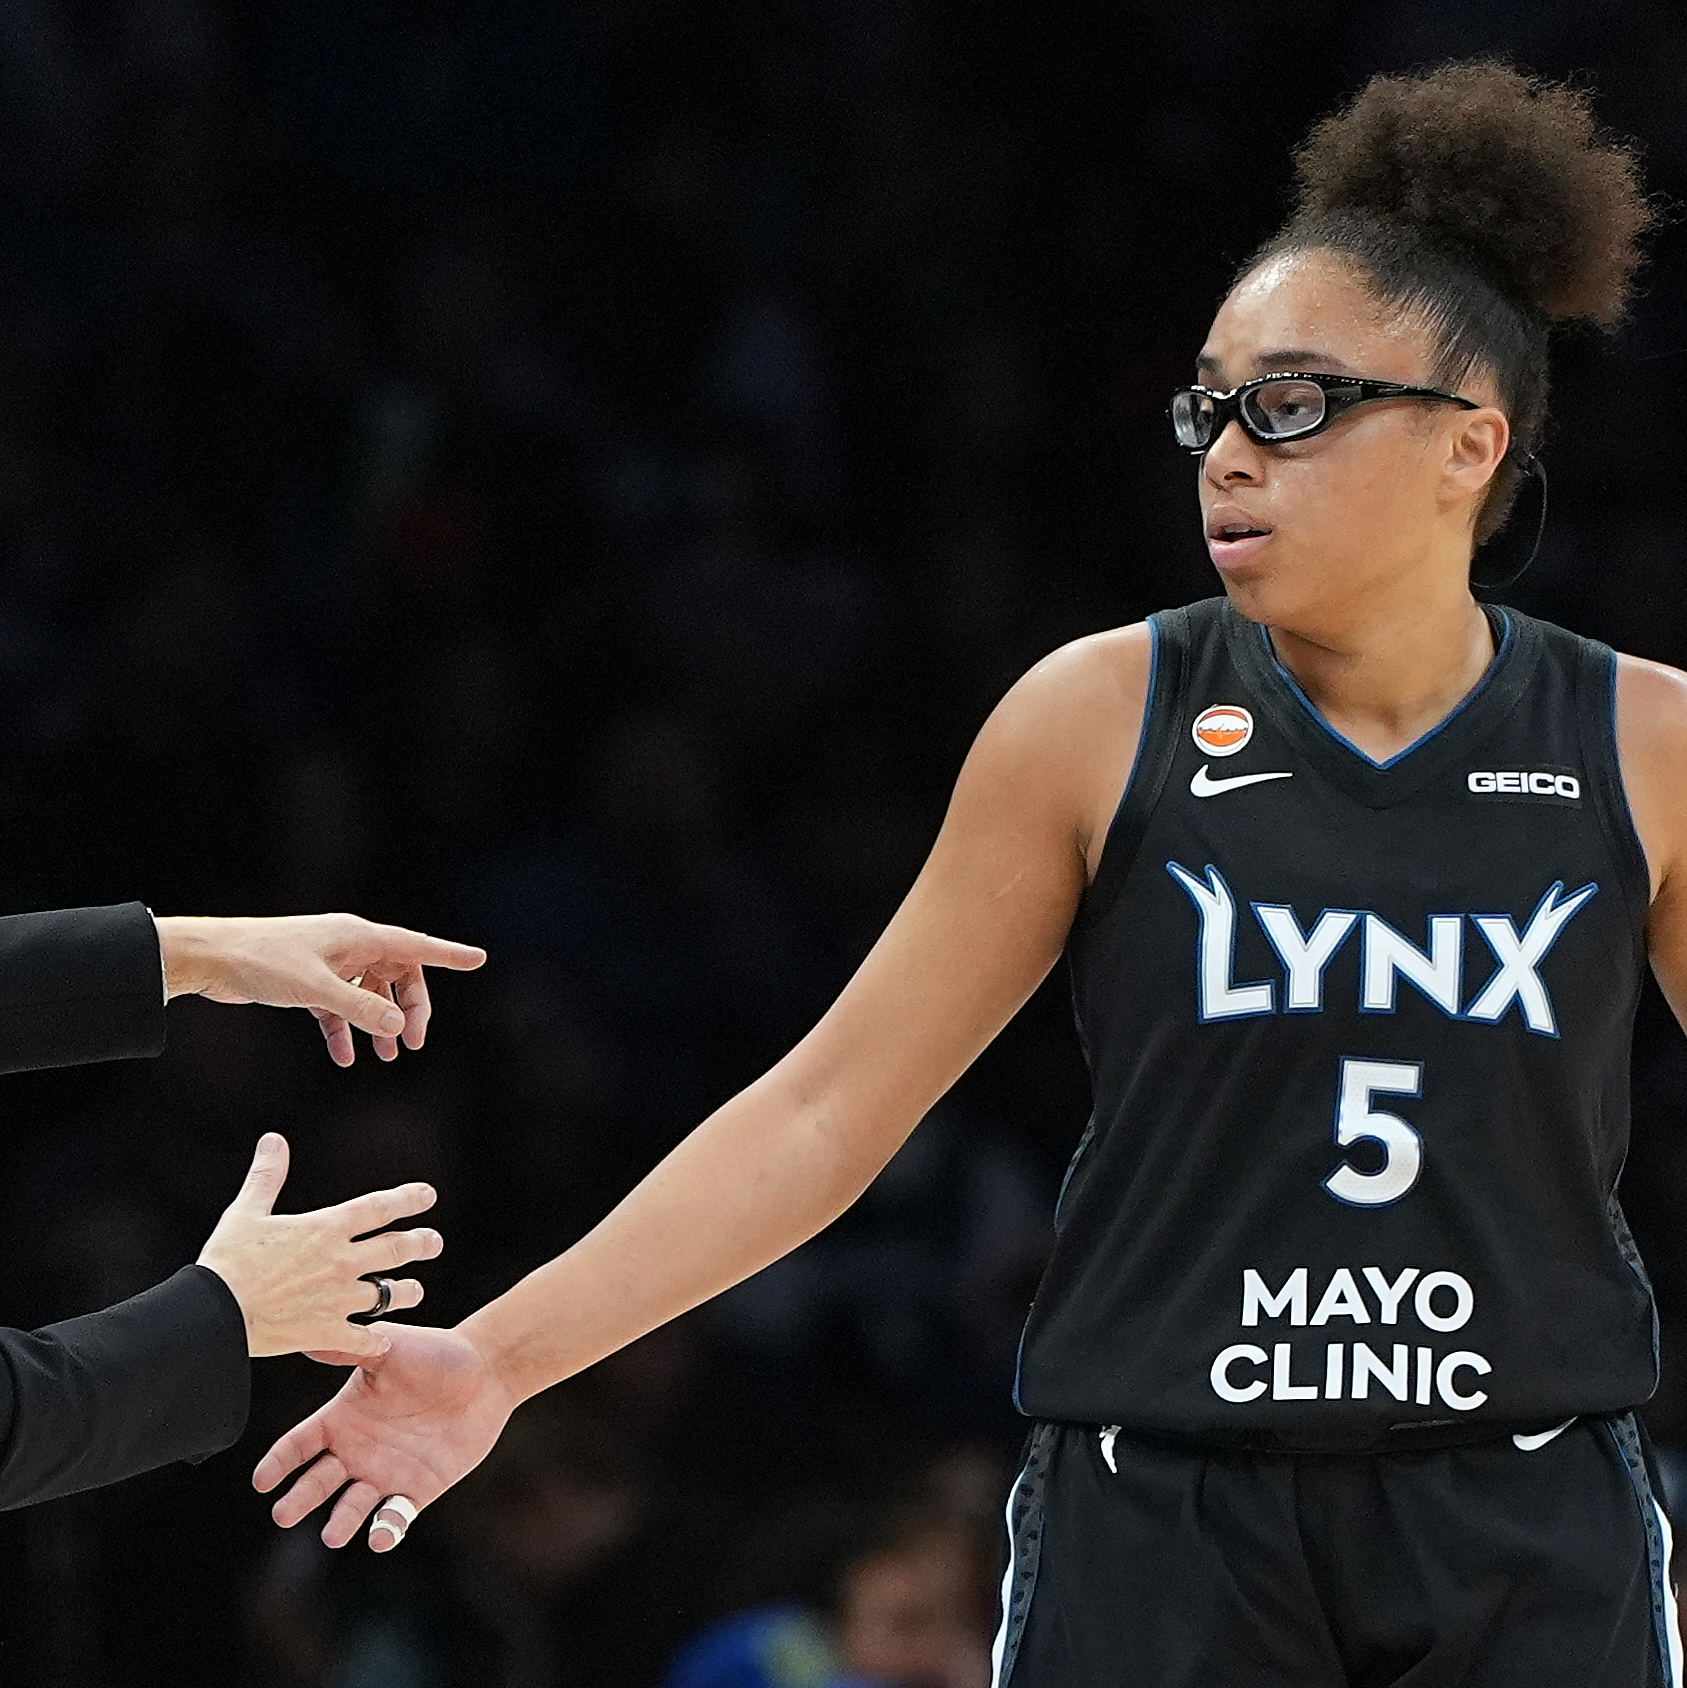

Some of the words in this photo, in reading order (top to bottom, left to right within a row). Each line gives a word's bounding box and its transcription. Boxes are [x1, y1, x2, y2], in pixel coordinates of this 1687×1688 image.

[1467, 771, 1581, 799] GEICO
[1165, 860, 1599, 1039] LYNX
[1323, 1057, 1423, 1206] 5
[1241, 1266, 1474, 1333] MAYO
[1210, 1342, 1492, 1411] CLINIC
